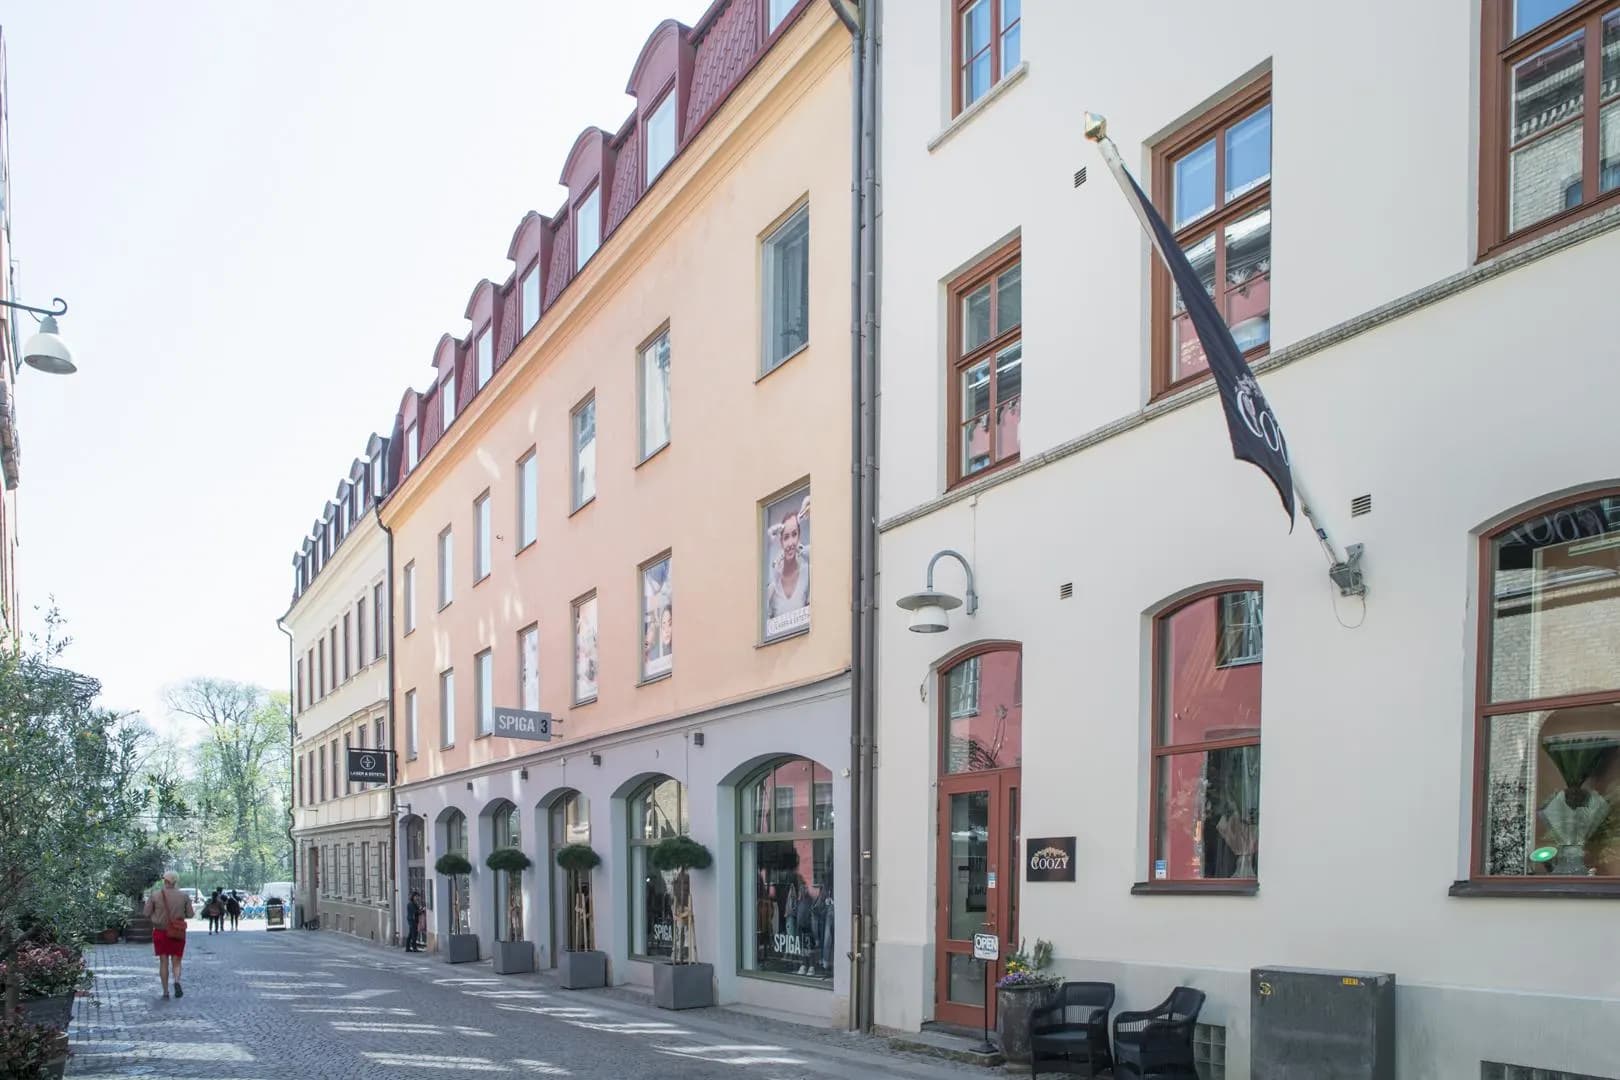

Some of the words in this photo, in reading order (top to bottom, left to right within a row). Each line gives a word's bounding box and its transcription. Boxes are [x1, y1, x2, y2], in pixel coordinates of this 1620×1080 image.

[499, 715, 535, 733] SPIGA
[541, 719, 548, 734] 3
[1031, 857, 1069, 870] COOZY
[654, 923, 673, 941] SPIGA
[774, 933, 801, 954] SPIGA
[976, 937, 998, 950] OPEN
